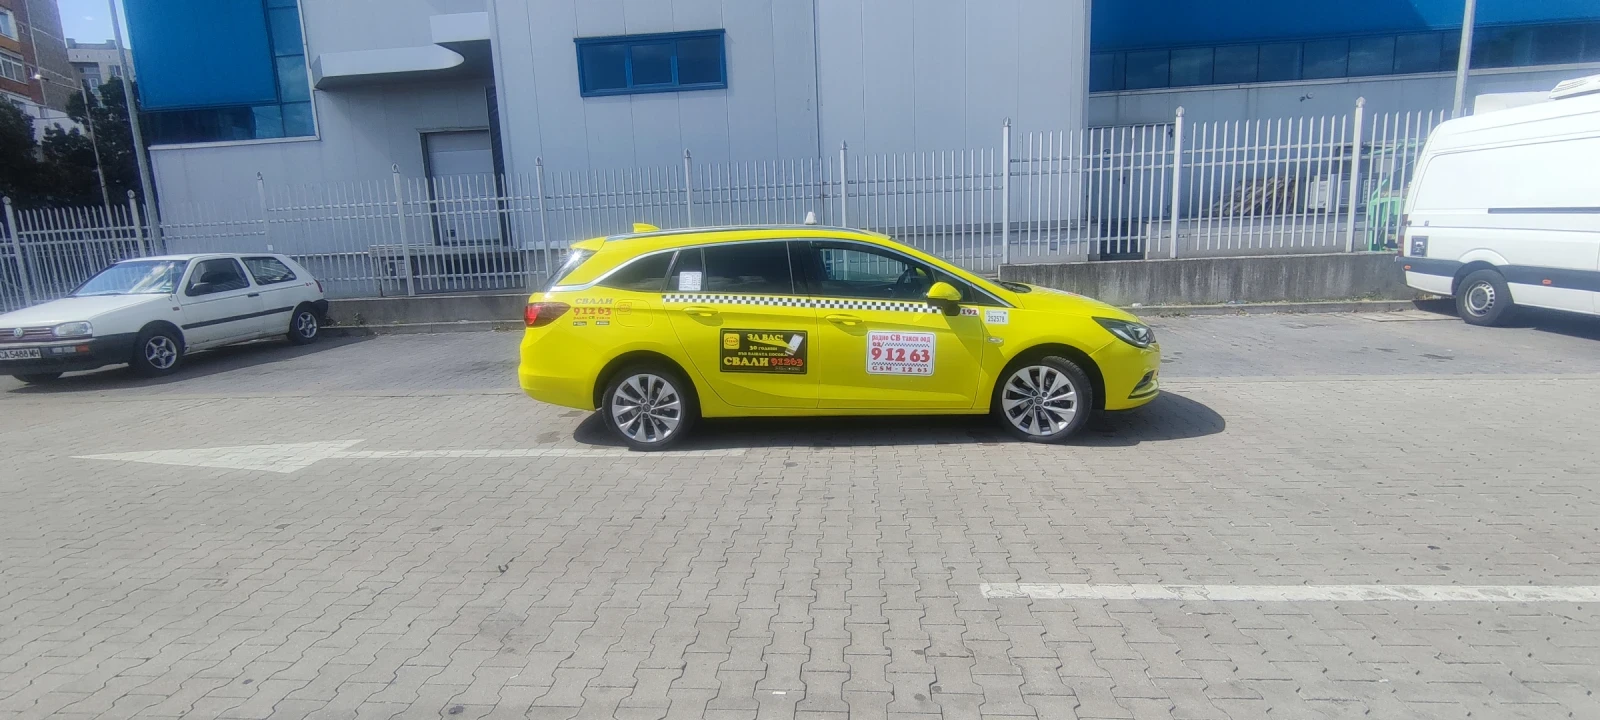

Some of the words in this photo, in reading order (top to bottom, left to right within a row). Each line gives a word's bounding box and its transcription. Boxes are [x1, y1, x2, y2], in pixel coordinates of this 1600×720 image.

[574, 307, 580, 315] 9
[598, 307, 611, 315] 63
[871, 348, 882, 360] 9
[885, 348, 906, 362] 12
[910, 349, 930, 362] 63
[724, 356, 769, 366] СВАЛИ
[770, 358, 804, 366] 91263
